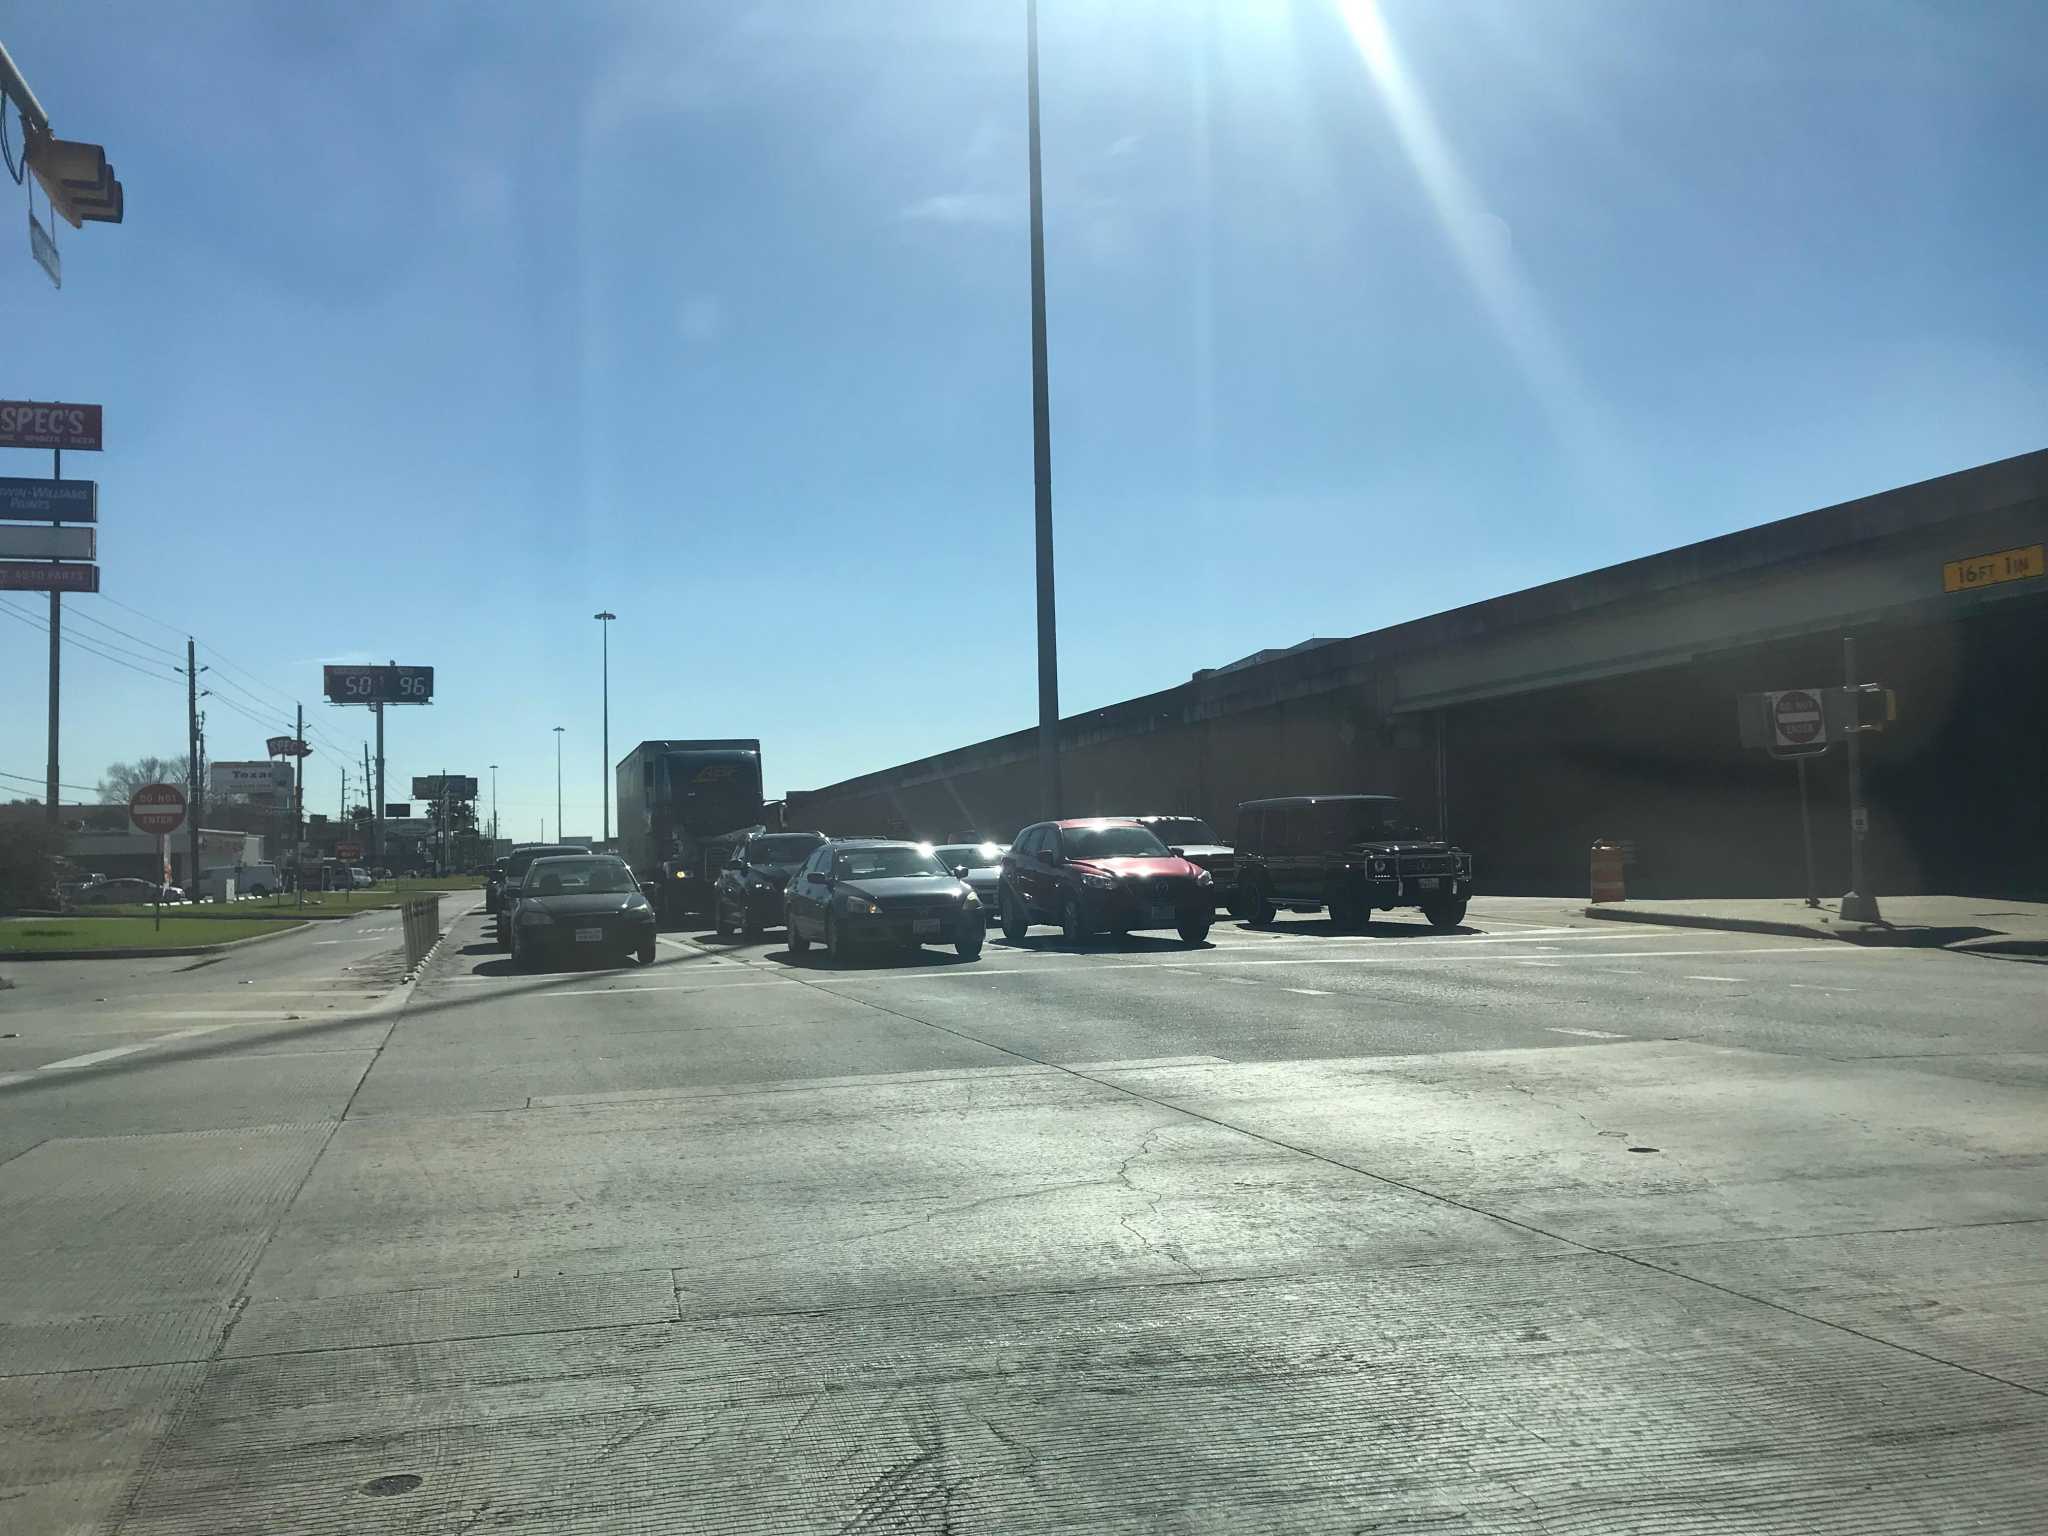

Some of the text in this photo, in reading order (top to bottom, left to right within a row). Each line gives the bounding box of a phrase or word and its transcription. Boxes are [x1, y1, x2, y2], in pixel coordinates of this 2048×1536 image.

[1, 407, 84, 434] SPEC'S
[346, 676, 424, 695] 50 96
[139, 793, 177, 803] DO NOT
[142, 815, 174, 825] ENTER
